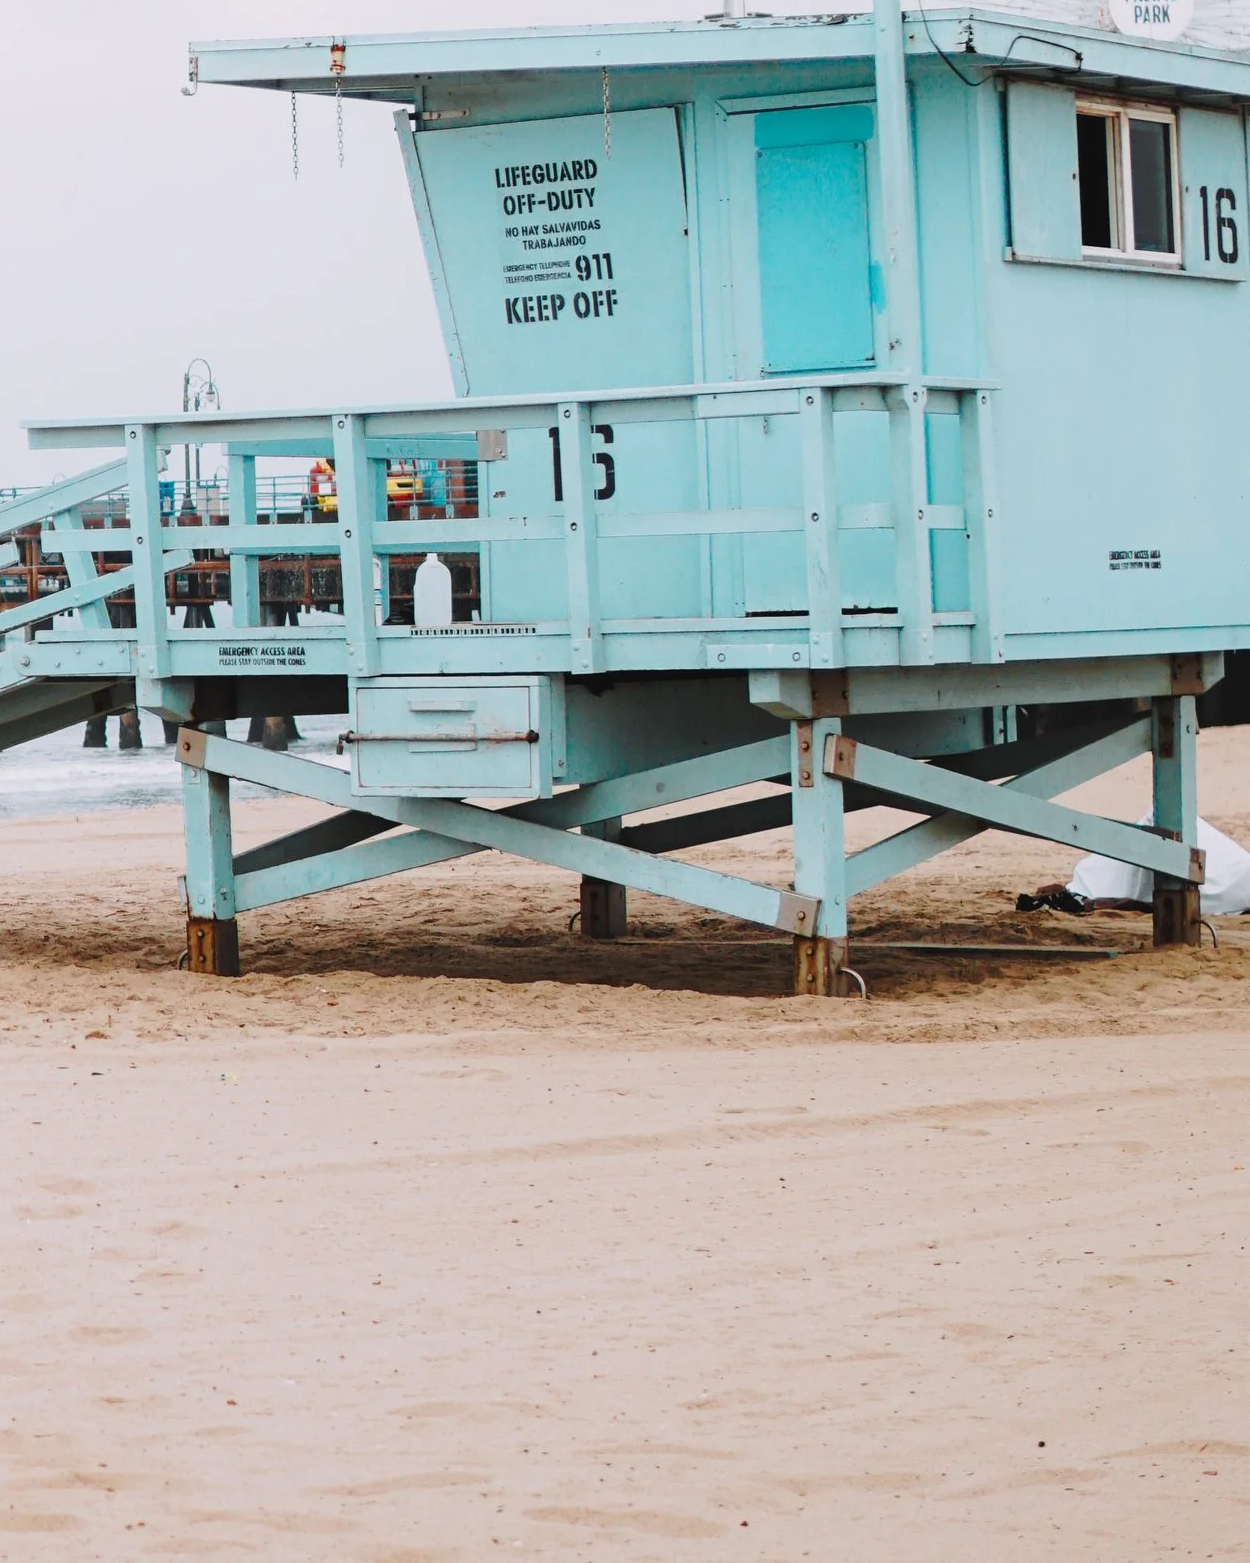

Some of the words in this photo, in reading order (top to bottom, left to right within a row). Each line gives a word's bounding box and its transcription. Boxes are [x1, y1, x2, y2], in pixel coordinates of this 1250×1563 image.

[1134, 4, 1171, 24] PARK
[495, 159, 598, 188] LIFEGUARD
[503, 188, 596, 216] OFF-DUTY
[505, 226, 519, 238] NO
[521, 225, 539, 237] HAY
[542, 219, 601, 235] SALVAVIDAS
[1200, 186, 1239, 264] 16
[522, 235, 587, 251] TRABAJANDO
[575, 253, 614, 282] 911
[505, 293, 566, 325] KEEP
[573, 289, 619, 319] OFF
[218, 647, 259, 657] EMERGENCY
[260, 646, 286, 656] ACCESS
[287, 646, 306, 656] AREA
[238, 658, 251, 666] STAY
[276, 658, 287, 666] THE
[287, 658, 306, 666] CONES
